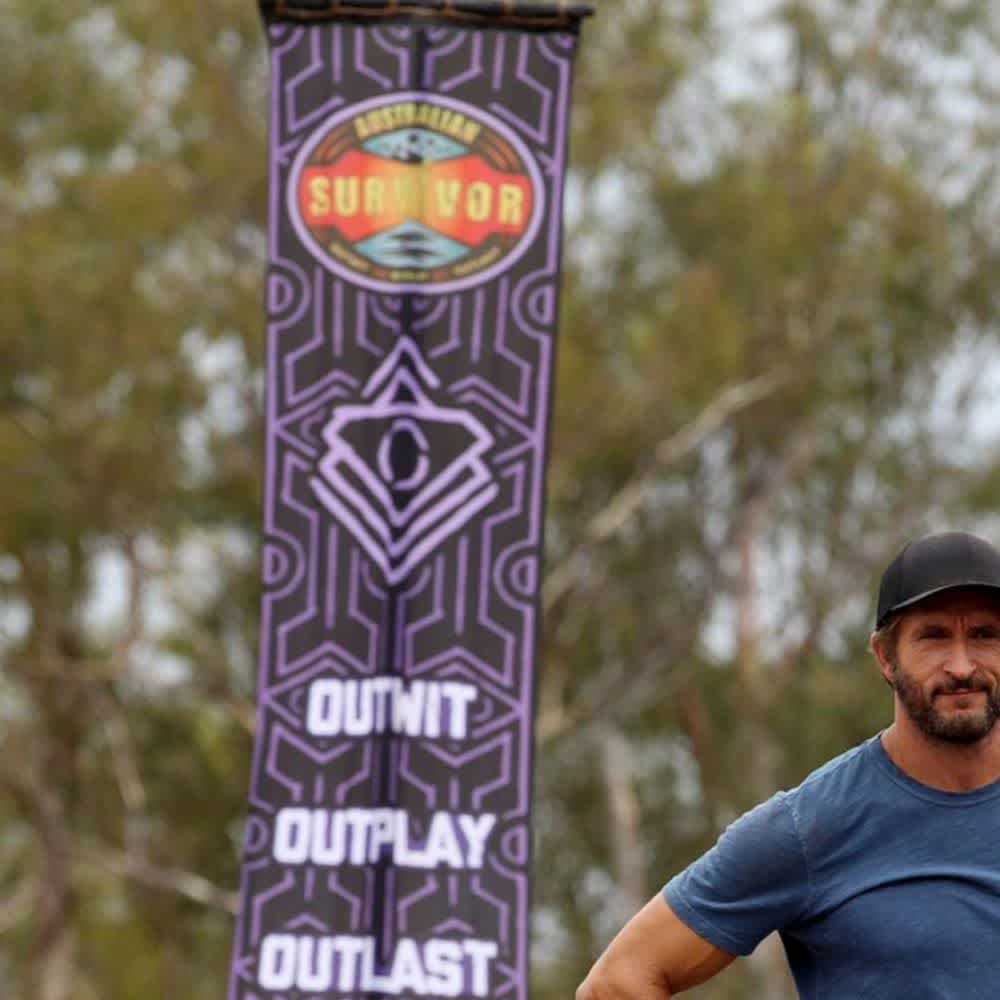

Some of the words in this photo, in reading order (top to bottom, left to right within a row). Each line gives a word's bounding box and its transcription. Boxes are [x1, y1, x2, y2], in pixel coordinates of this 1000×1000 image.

[308, 176, 524, 225] SURVVOR
[305, 677, 477, 740] OUTWIT
[272, 807, 496, 869] OUTPLAY
[257, 933, 498, 997] OUTLAST
